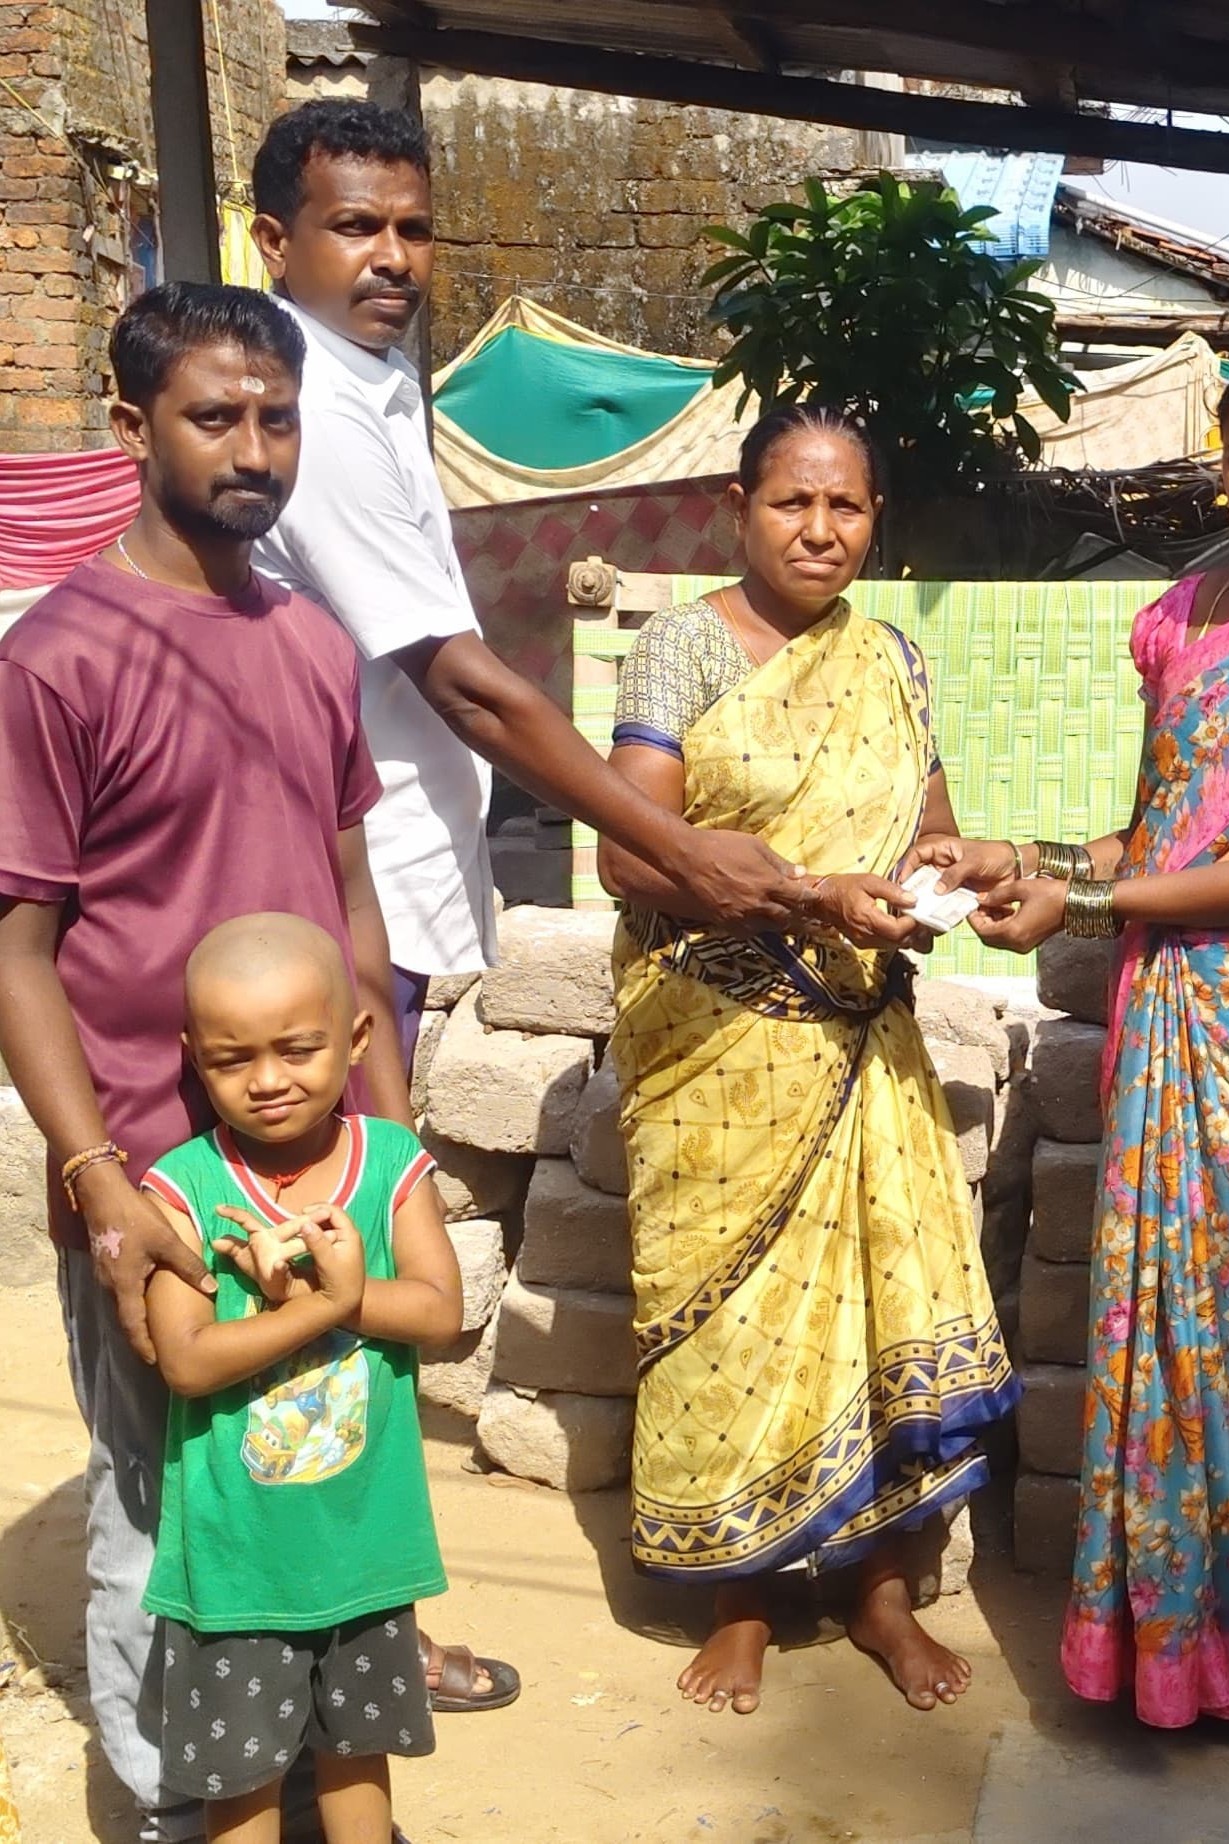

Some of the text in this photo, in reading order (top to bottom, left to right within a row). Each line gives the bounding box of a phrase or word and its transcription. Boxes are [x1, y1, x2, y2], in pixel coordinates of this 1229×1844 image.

[384, 1619, 399, 1639] $
[281, 1645, 294, 1665] $
[355, 1654, 371, 1674] $
[215, 1656, 231, 1679] $
[247, 1675, 262, 1698] $
[392, 1675, 406, 1697] $
[189, 1687, 201, 1710] $
[279, 1697, 295, 1720] $
[330, 1687, 346, 1708] $
[363, 1701, 381, 1721] $
[210, 1717, 226, 1741] $
[398, 1727, 412, 1748] $
[183, 1741, 197, 1763] $
[244, 1736, 260, 1759] $
[336, 1738, 352, 1758] $
[206, 1772, 223, 1794] $
